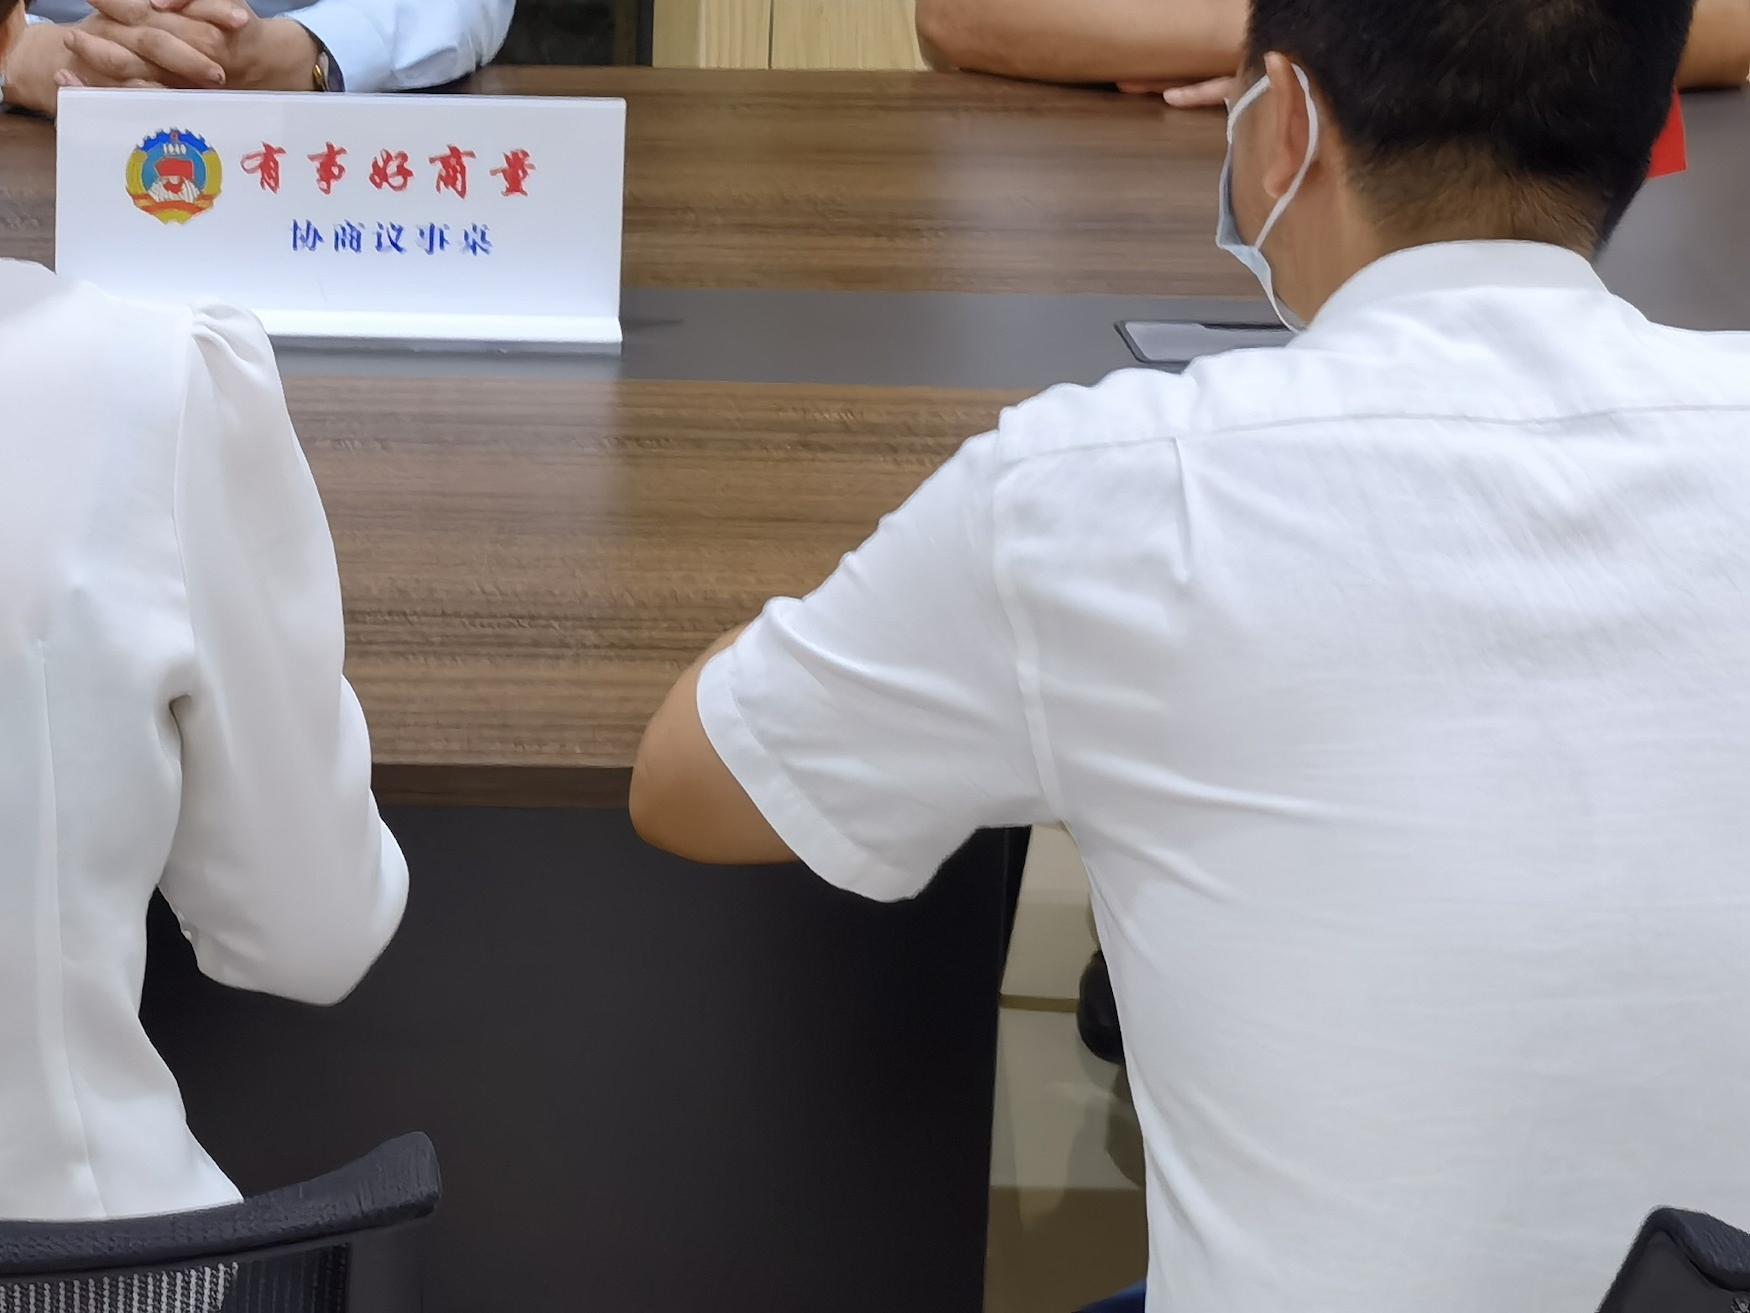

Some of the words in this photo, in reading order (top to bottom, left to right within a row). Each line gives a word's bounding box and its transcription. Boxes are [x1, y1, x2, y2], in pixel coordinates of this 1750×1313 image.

[240, 141, 536, 199] 有事好商量
